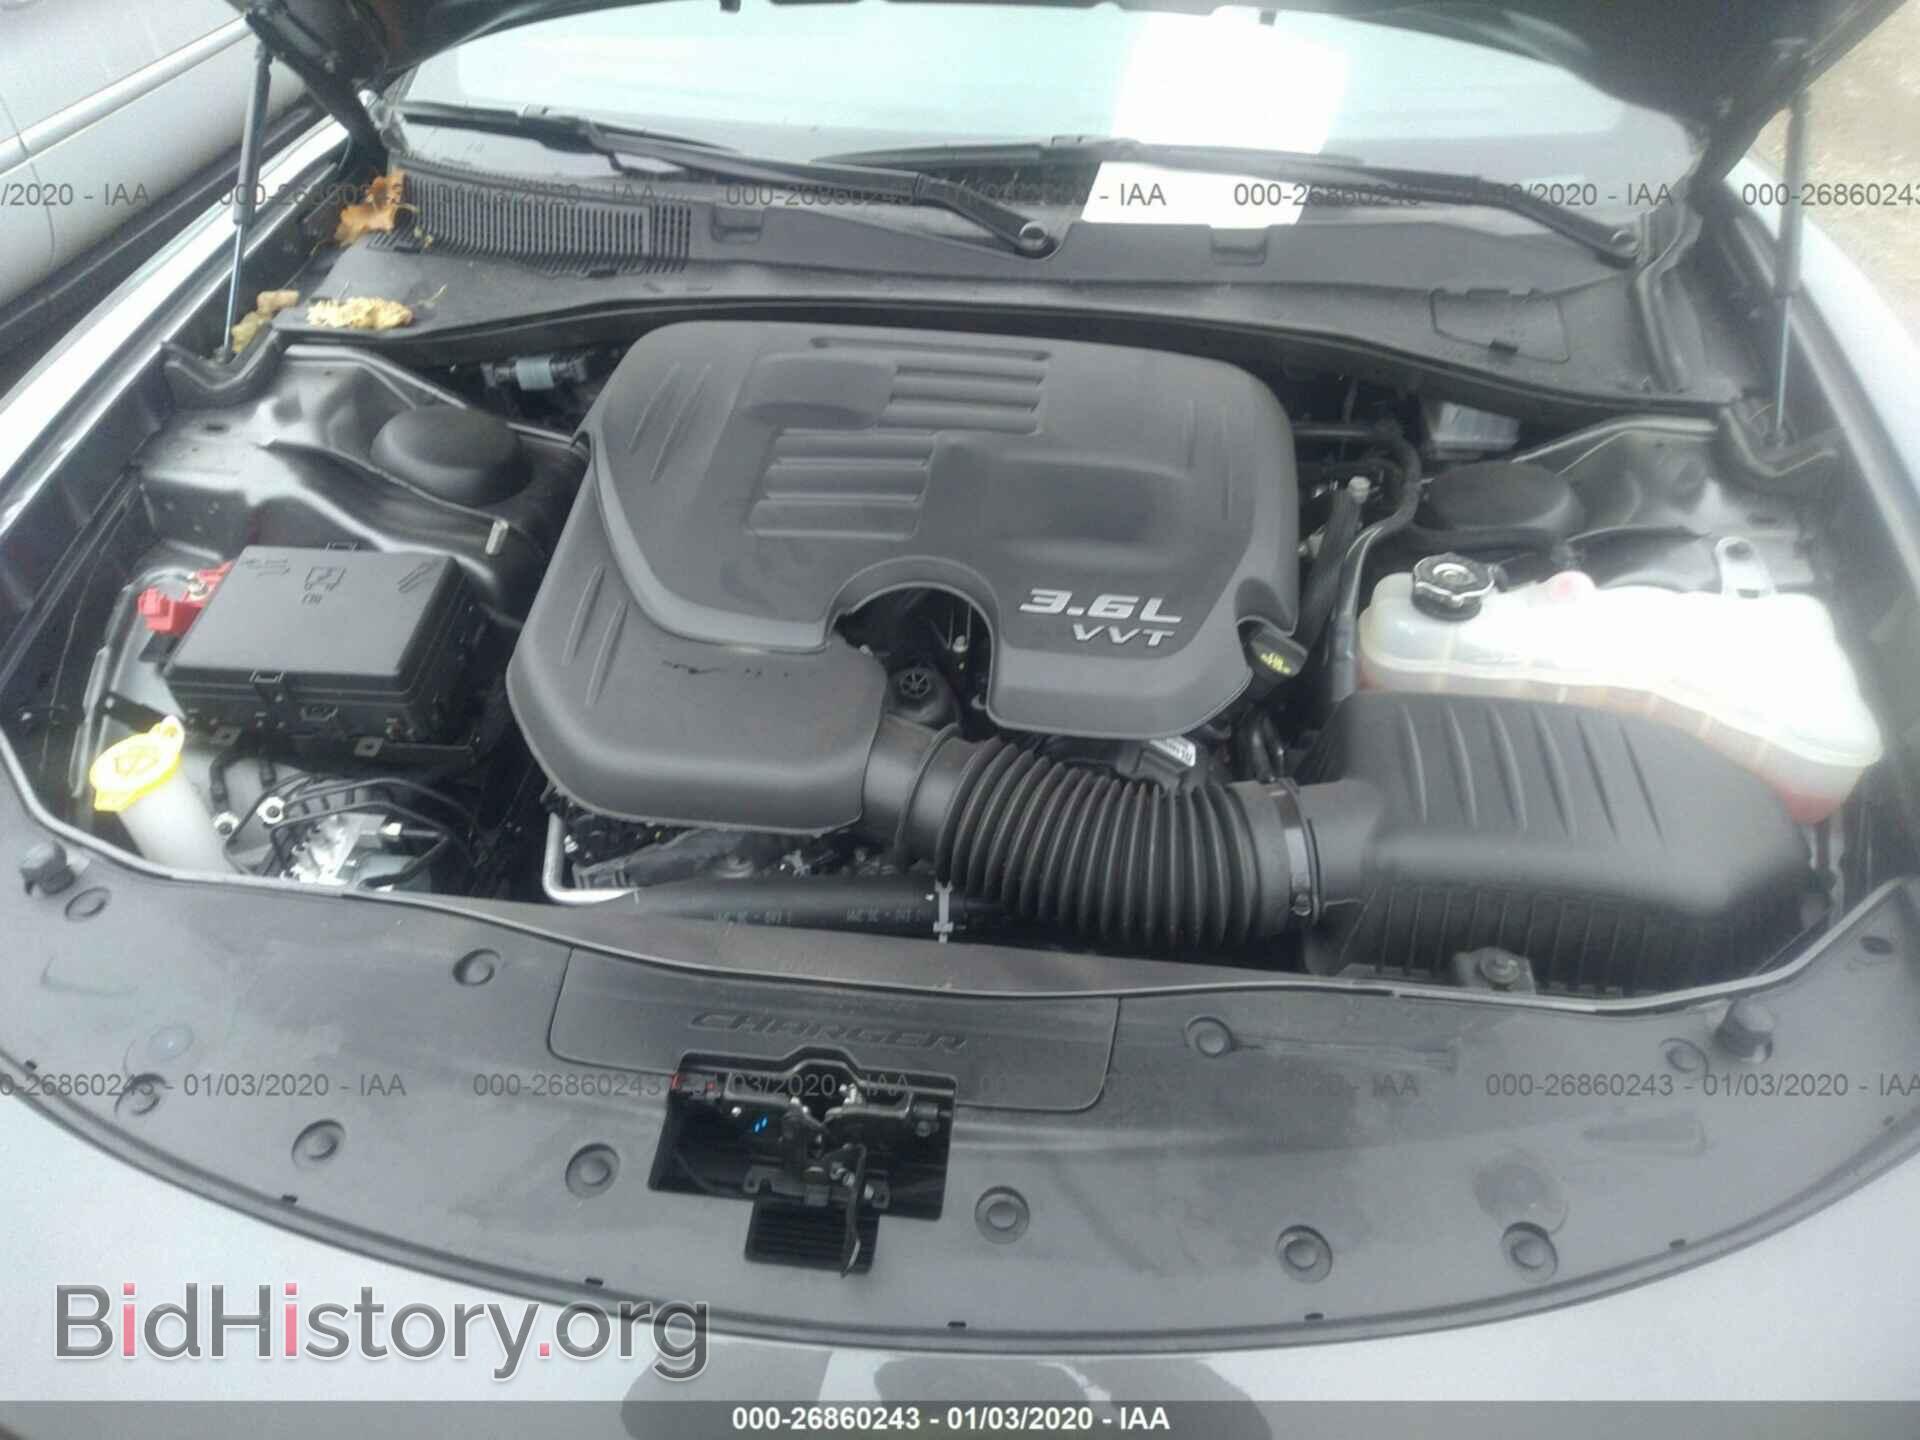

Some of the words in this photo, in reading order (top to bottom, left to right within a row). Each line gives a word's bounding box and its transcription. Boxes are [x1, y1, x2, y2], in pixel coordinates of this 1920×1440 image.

[1019, 587, 1183, 624] 3.6L
[1072, 623, 1175, 647] VVT
[688, 1011, 969, 1050] CHARGER
